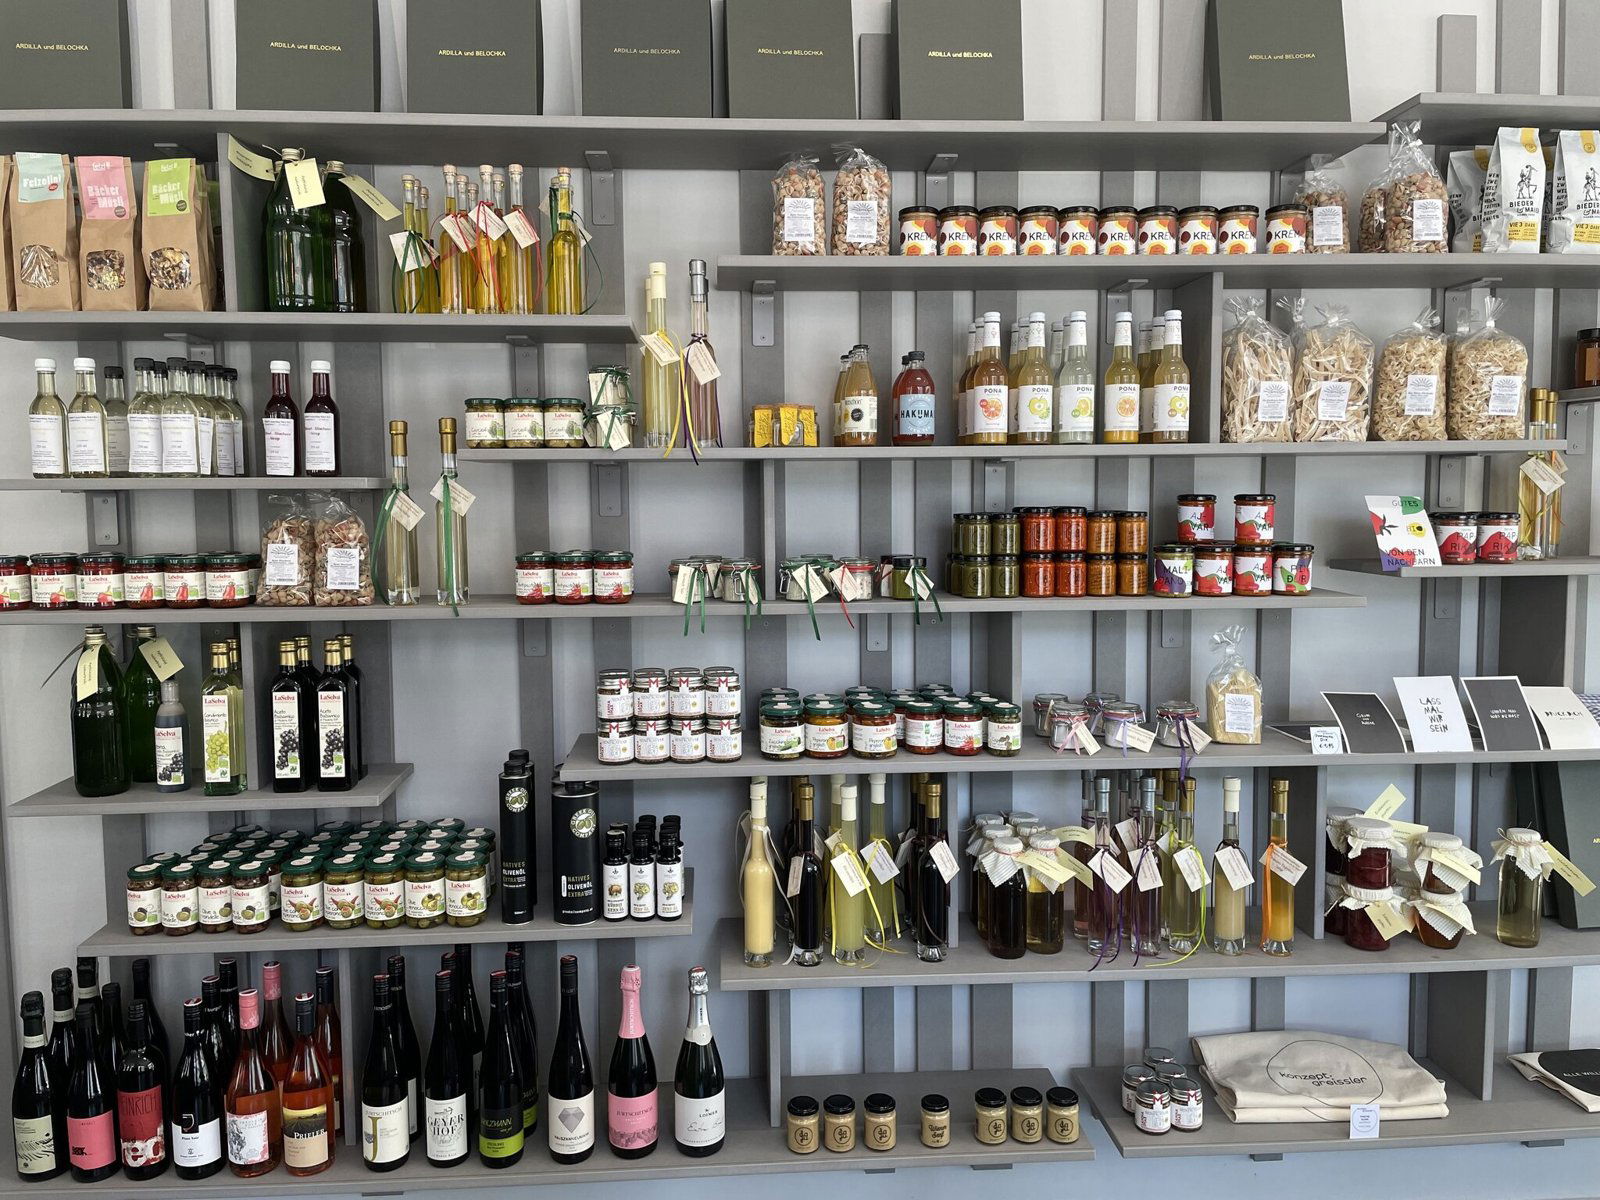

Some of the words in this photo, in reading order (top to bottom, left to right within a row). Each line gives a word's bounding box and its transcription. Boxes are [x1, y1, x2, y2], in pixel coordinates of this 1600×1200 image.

[270, 41, 296, 49] ARDILLA
[309, 44, 341, 52] BELOCHKA
[1510, 200, 1534, 208] BIEDER
[901, 410, 933, 419] HAKUMA
[1191, 523, 1208, 531] VAR
[1254, 523, 1271, 531] VAR
[1385, 548, 1404, 556] VON
[1407, 548, 1424, 556] DEN
[1419, 697, 1442, 706] LASS
[1424, 706, 1443, 714] MAL
[1429, 714, 1443, 723] WIR
[1429, 723, 1448, 733] SEIN
[505, 787, 520, 800] GREEK
[506, 801, 528, 812] COMPANY
[571, 808, 587, 825] GREEK
[572, 824, 596, 838] COMPANY
[568, 881, 592, 890] OLIVENÖL
[1312, 1076, 1367, 1087] greissler
[428, 1114, 464, 1126] GEYER
[294, 1128, 325, 1140] PRIELER
[433, 1125, 457, 1136] HOF
